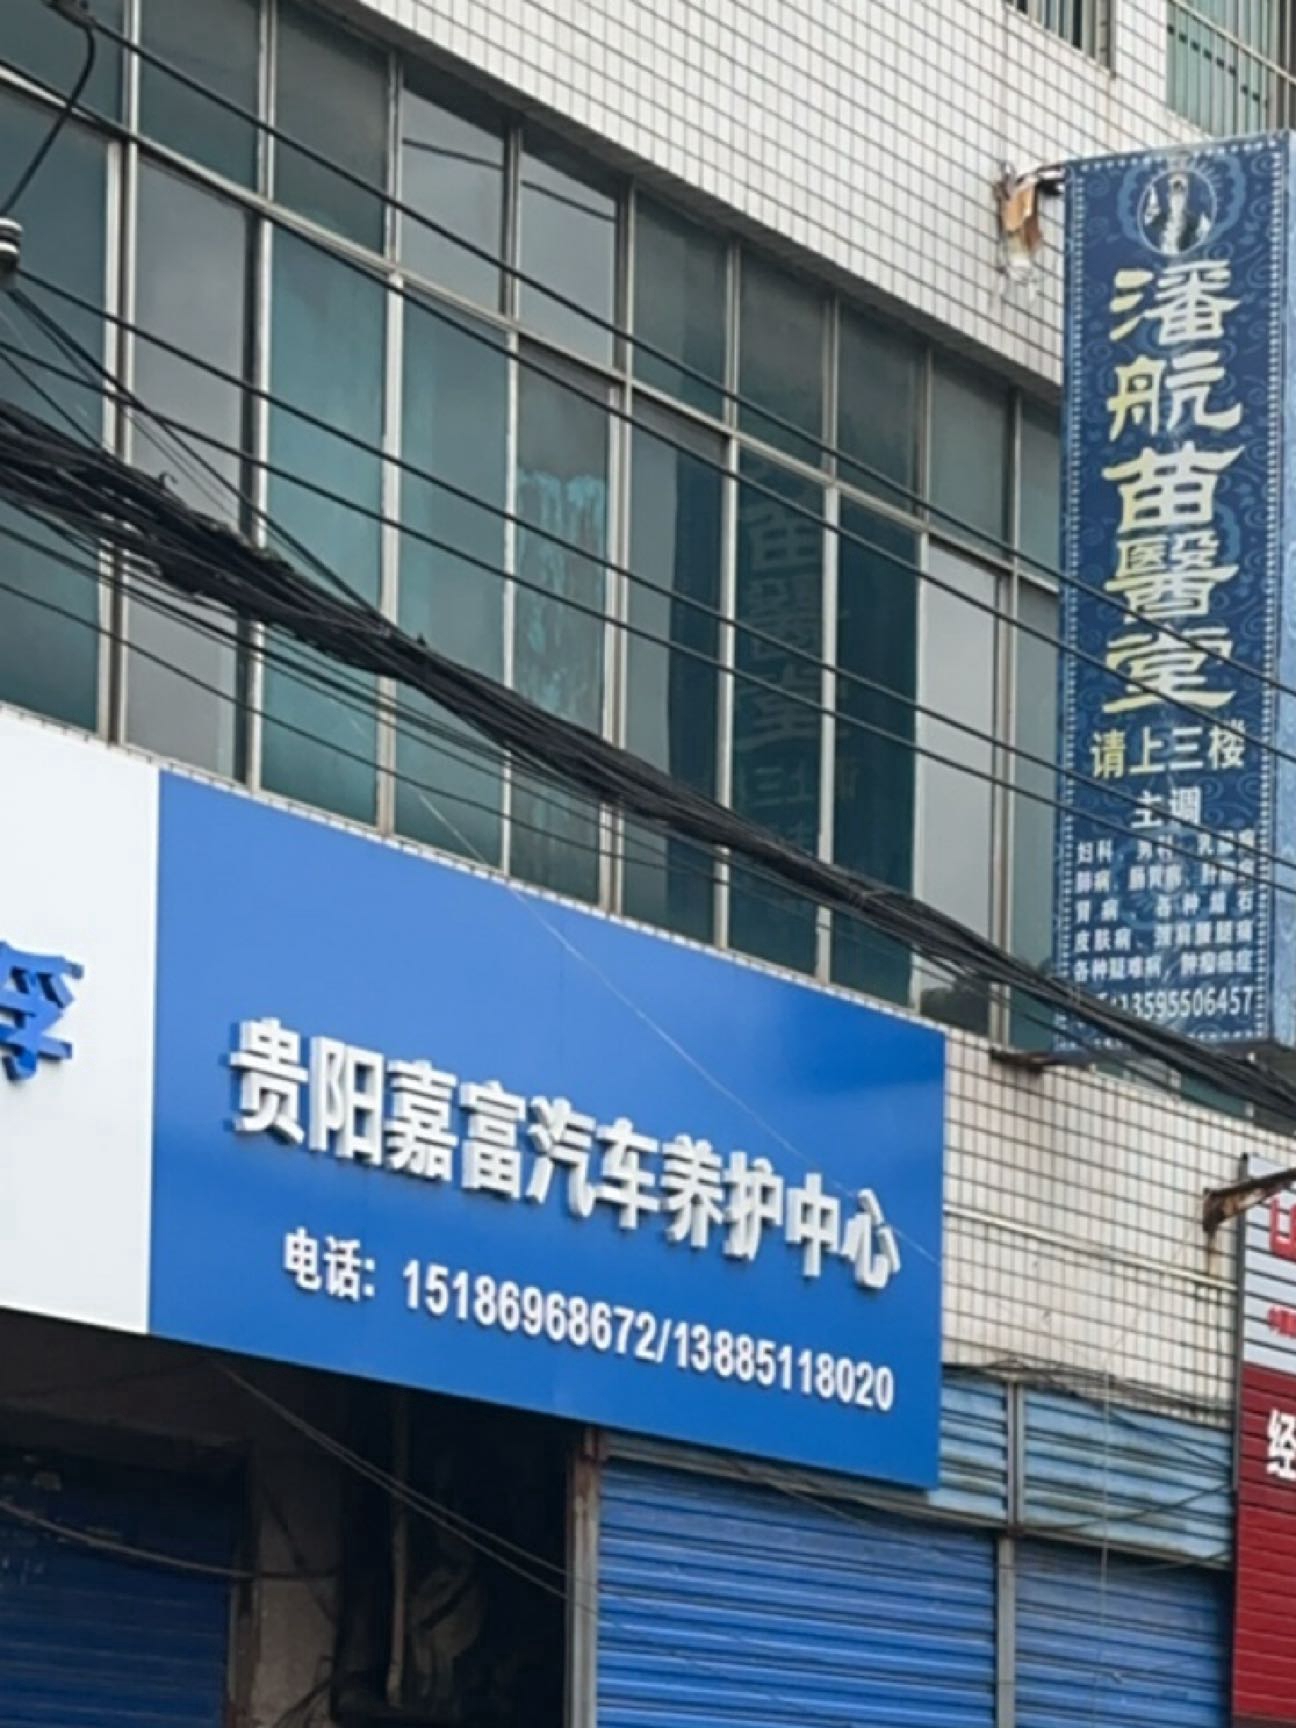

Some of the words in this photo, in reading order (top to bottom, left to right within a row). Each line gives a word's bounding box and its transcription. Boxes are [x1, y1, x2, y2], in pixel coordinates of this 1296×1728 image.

[1089, 718, 1246, 780] 请上三楼
[230, 1016, 900, 1290] 贵阳嘉富汽车养护中心
